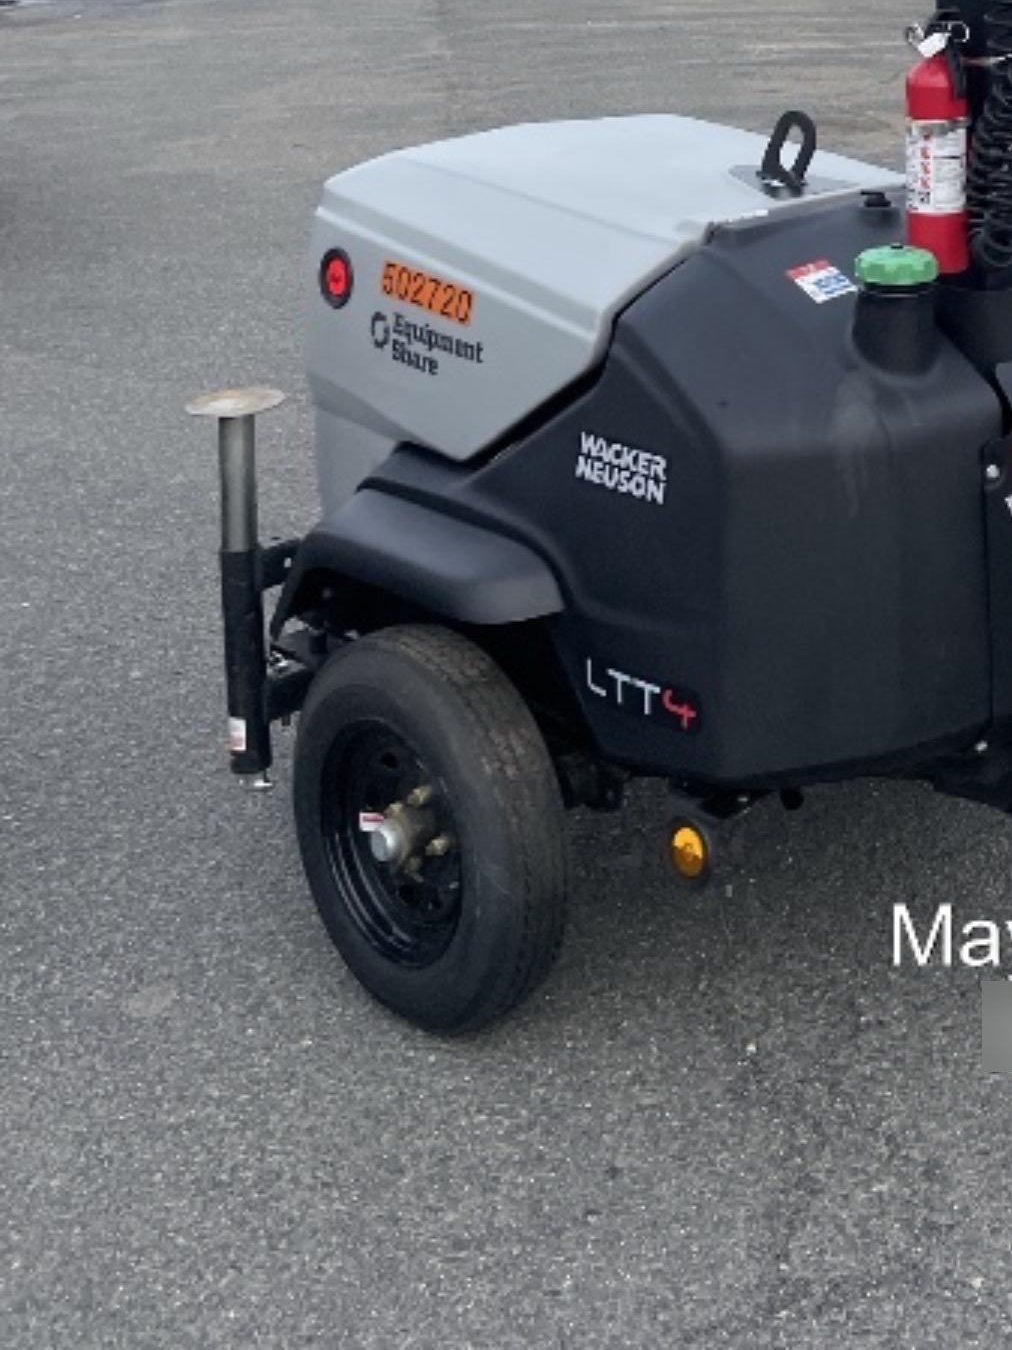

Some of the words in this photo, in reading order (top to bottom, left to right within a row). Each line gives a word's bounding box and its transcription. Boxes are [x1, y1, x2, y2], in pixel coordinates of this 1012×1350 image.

[382, 262, 472, 323] 502720
[391, 338, 439, 376] Share
[392, 311, 484, 364] Equipment
[576, 455, 667, 505] NEUSON
[580, 431, 667, 481] WACKER
[586, 657, 697, 730] LTT4
